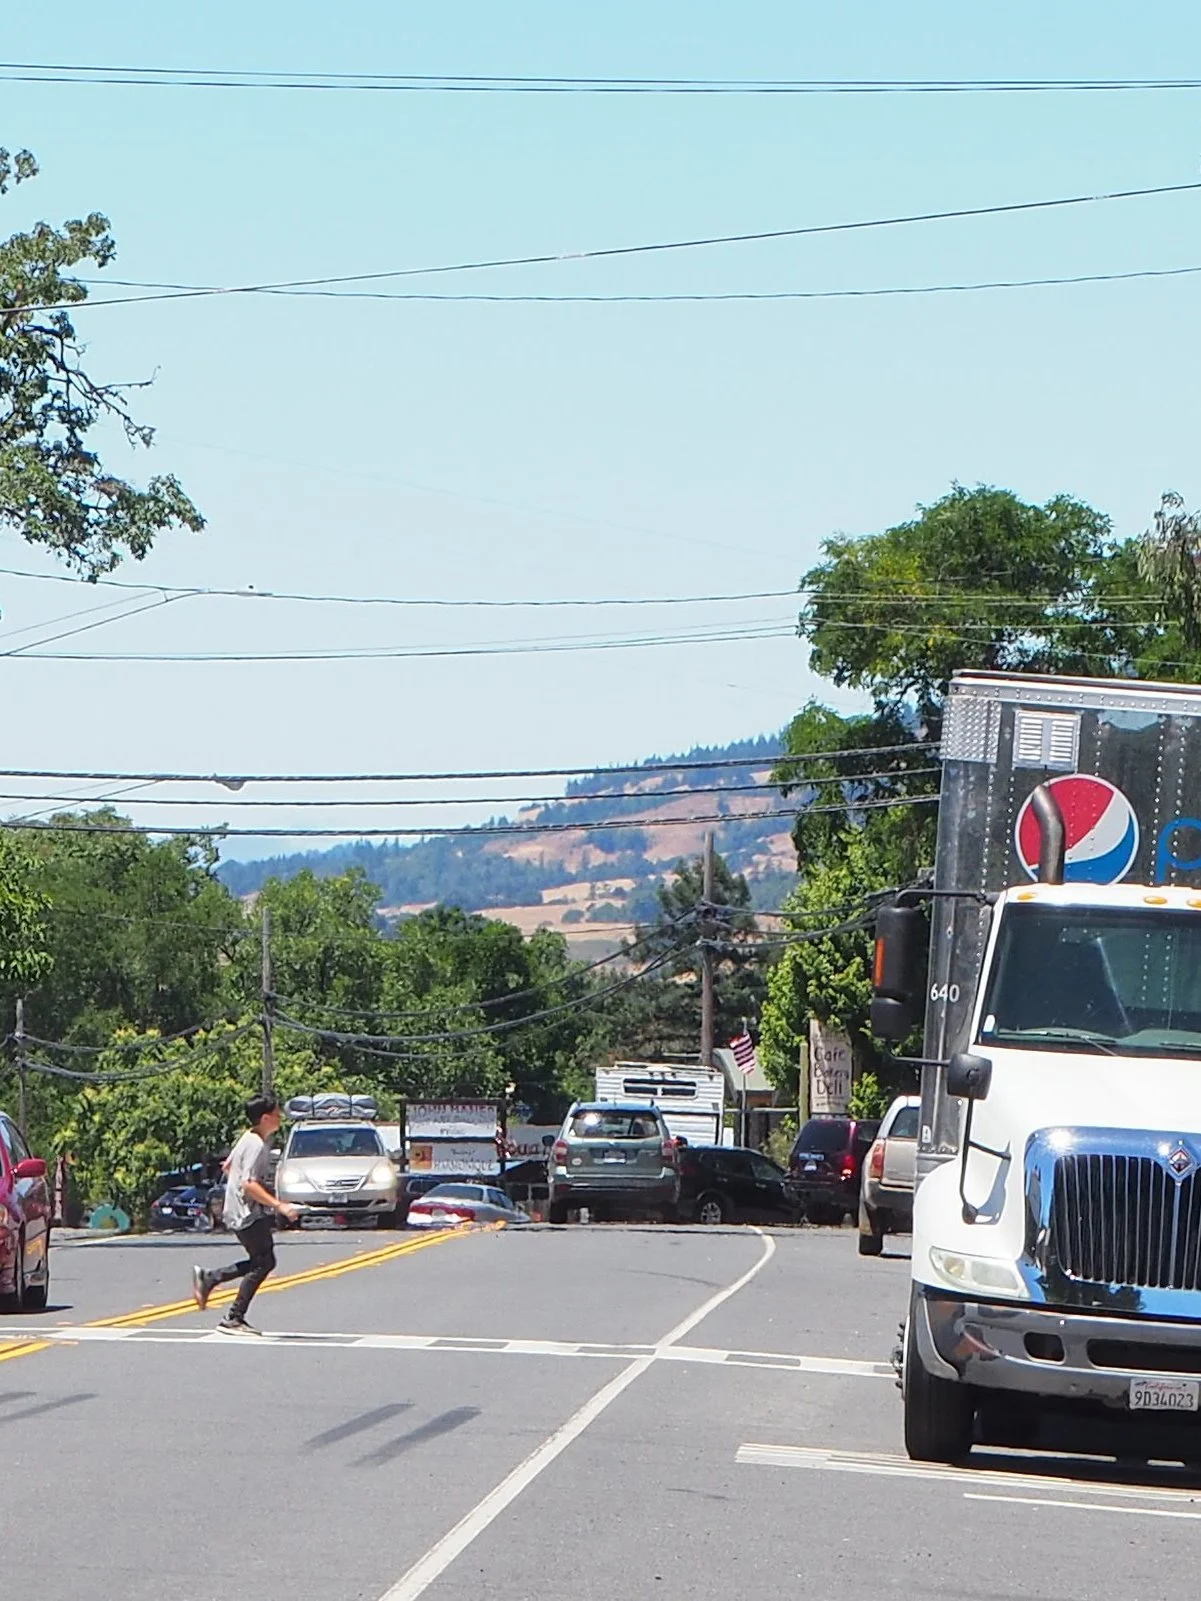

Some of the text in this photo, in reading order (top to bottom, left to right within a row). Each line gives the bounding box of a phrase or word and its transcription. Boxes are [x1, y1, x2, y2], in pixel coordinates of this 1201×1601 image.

[930, 983, 960, 1003] 640
[816, 1079, 842, 1095] Deli
[1134, 1390, 1194, 1408] 9D34023
